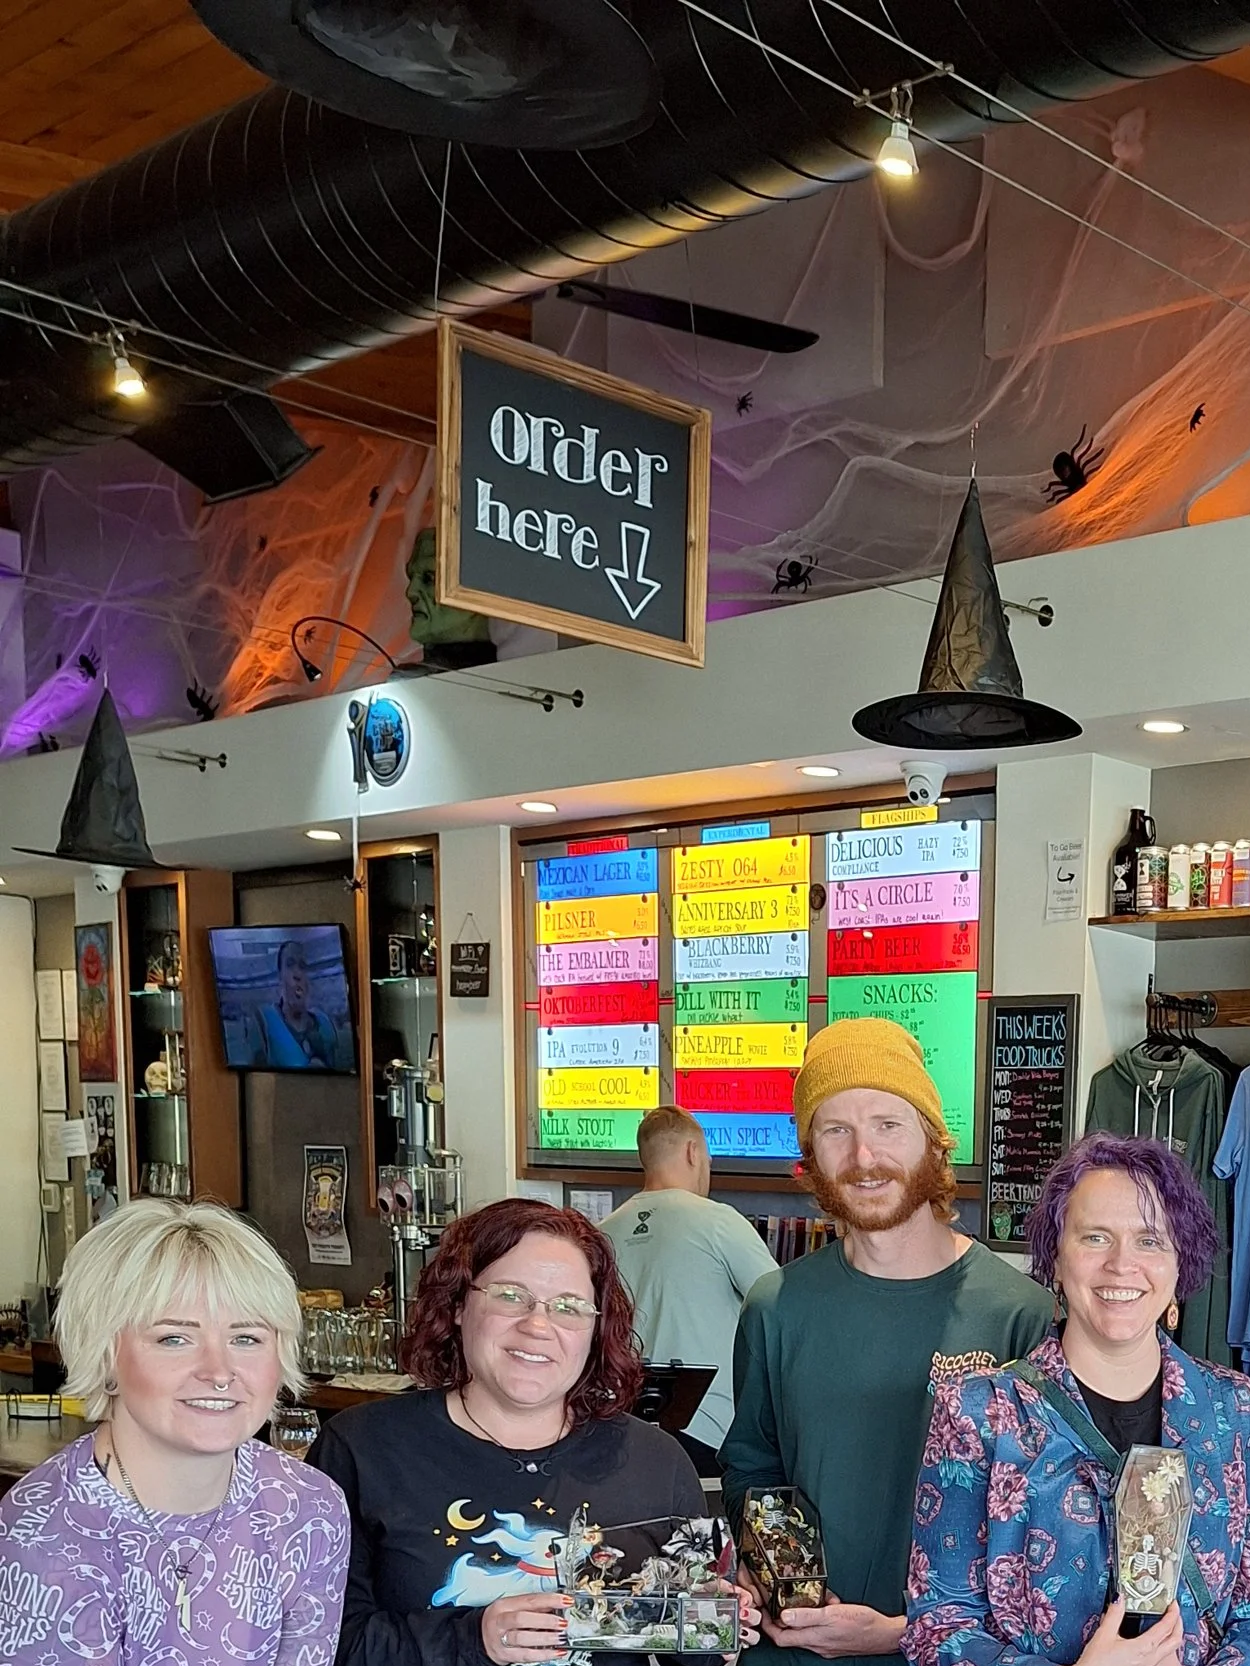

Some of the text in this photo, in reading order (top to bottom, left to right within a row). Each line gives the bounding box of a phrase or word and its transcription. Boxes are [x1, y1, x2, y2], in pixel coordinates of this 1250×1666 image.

[490, 405, 669, 509] Order
[475, 478, 599, 569] here
[871, 811, 927, 825] FLAGSHIPS
[831, 835, 903, 863] DELICIOUS
[922, 850, 935, 862] IPA
[538, 861, 631, 887] MEXICAN LAGER
[680, 858, 725, 881] ZESTY
[832, 861, 879, 876] COMPLIANCE
[865, 887, 874, 907] A
[877, 882, 934, 906] CIRCLE
[544, 910, 596, 932] PILSNER
[677, 899, 778, 923] ANNIVERSARY 3
[905, 913, 919, 922] cool
[688, 935, 773, 958] BLACKBERRY
[831, 935, 921, 961] PARTY BEER
[541, 950, 630, 972] THE EMBALMER
[543, 994, 626, 1016] OKTOBERFEST
[675, 990, 761, 1012] DILL WITH IT
[863, 983, 938, 1005] SNACKS:
[832, 1010, 860, 1021] POTATO
[869, 1009, 895, 1020] CHIPS
[996, 1014, 1023, 1040] THIS
[547, 1040, 566, 1059] IPA
[612, 1038, 620, 1056] 9
[675, 1035, 744, 1056] PINEAPPLE
[995, 1044, 1065, 1067] FOOD TRUCKS
[543, 1078, 567, 1096] OLD
[599, 1076, 632, 1096] COOL
[541, 1118, 615, 1137] MILK STOUT
[704, 1126, 773, 1147] PKIN SPICE
